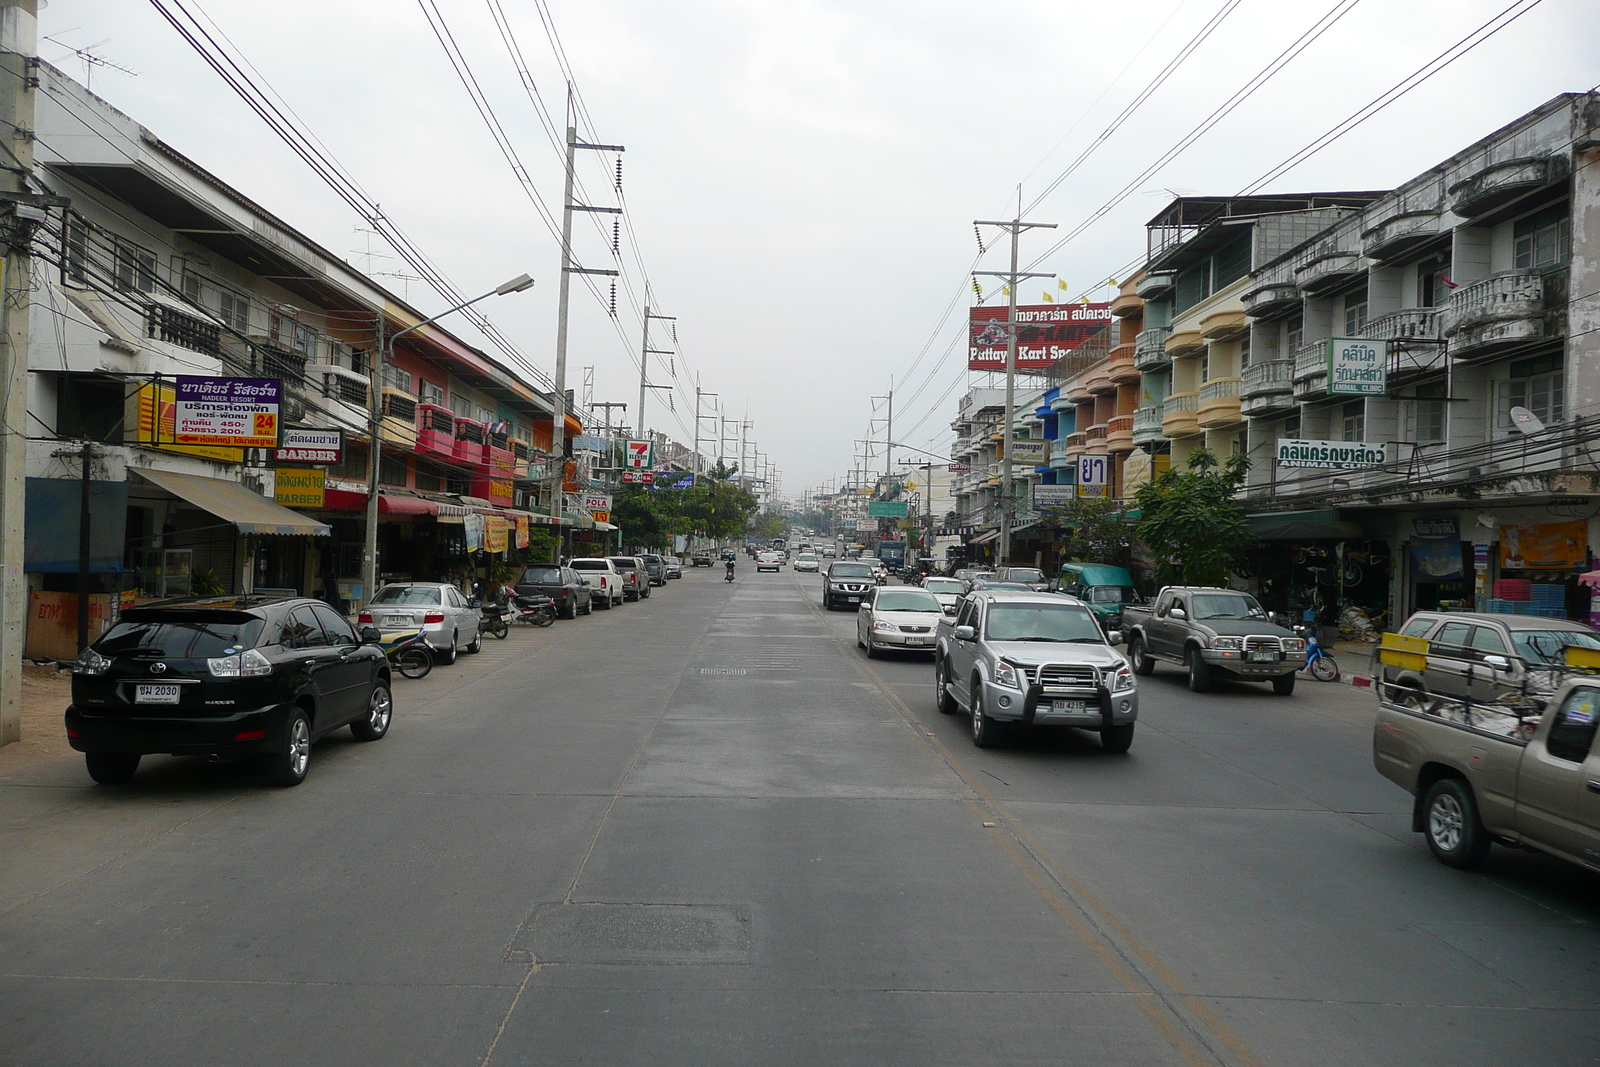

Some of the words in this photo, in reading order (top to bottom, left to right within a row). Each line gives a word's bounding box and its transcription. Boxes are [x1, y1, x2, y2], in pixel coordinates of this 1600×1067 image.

[970, 347, 1009, 363] Pattay
[1018, 346, 1047, 360] Kart
[256, 415, 274, 429] 24
[277, 449, 337, 461] BARBER
[630, 443, 648, 467] 7
[1280, 460, 1336, 468] ANIMAL
[1082, 458, 1104, 483] ยา
[276, 494, 322, 504] BARBER
[586, 499, 607, 507] POLA
[155, 686, 177, 696] 2030
